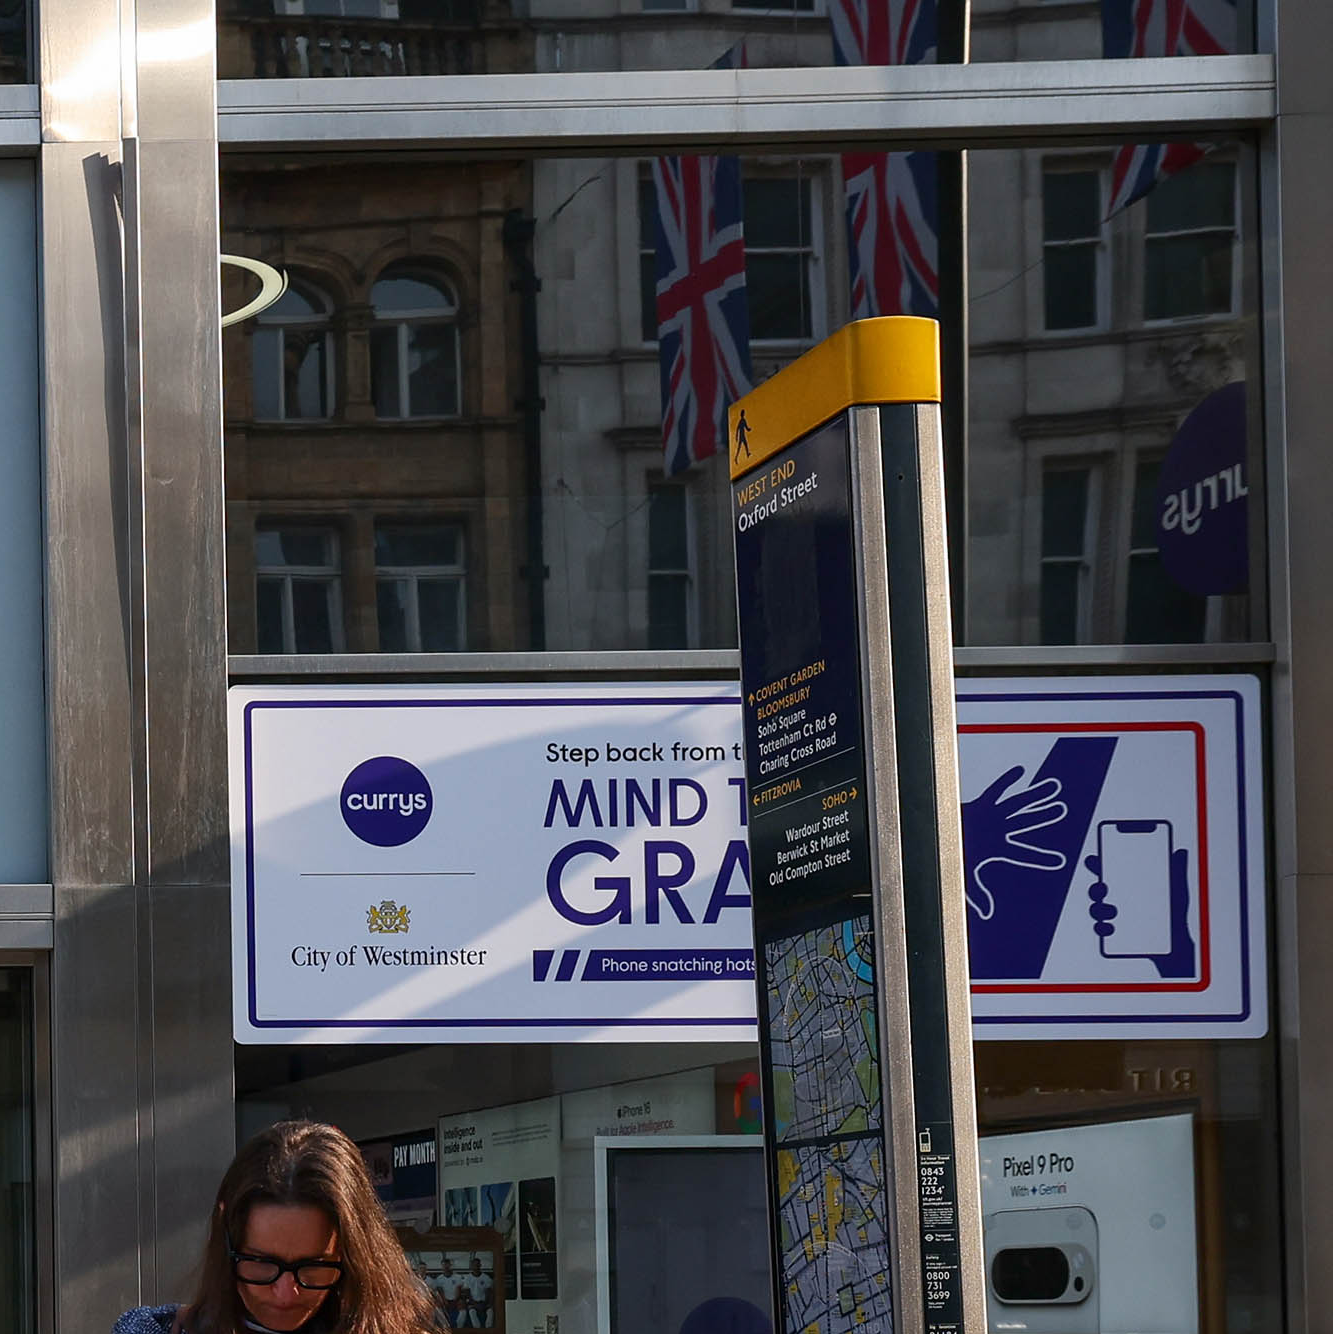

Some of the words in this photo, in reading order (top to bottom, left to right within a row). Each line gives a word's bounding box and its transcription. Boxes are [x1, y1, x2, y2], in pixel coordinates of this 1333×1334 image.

[737, 475, 768, 508] WEST
[770, 459, 796, 489] END
[738, 494, 778, 533] Oxford
[780, 471, 819, 508] Street
[756, 676, 789, 703] COVENT
[790, 659, 827, 687] GARDEN
[757, 685, 812, 721] BLOOMSBURY
[758, 722, 778, 740] Soho
[779, 708, 807, 731] Square
[759, 729, 802, 758] Tottenham
[803, 721, 814, 738] Ct
[816, 715, 827, 734] Rd
[546, 742, 599, 769] Step
[606, 742, 664, 763] back
[671, 741, 726, 762] from
[760, 754, 790, 776] Charing
[790, 741, 814, 762] Cross
[815, 731, 838, 753] Road
[345, 791, 429, 815] currys
[543, 778, 708, 828] MIND
[761, 777, 803, 804] FITZROVIA
[821, 790, 849, 811] SOHO
[785, 821, 822, 844] Wardour
[822, 809, 850, 831] Street
[776, 842, 809, 866] Berwick
[809, 839, 820, 855] St
[821, 829, 851, 851] Market
[768, 869, 784, 887] Old
[785, 858, 823, 880] Compton
[824, 848, 852, 869] Street
[545, 839, 752, 926] GRA
[291, 946, 331, 973] City
[335, 945, 358, 968] of
[362, 945, 488, 967] Westminster
[601, 957, 649, 973] Phone
[651, 957, 723, 976] snatching
[726, 955, 756, 973] hots
[444, 1126, 476, 1140] Intelligence
[461, 1140, 472, 1152] and
[473, 1138, 483, 1150] out
[394, 1145, 408, 1168] PAY
[1004, 1156, 1034, 1178] Pixel
[1038, 1155, 1046, 1174] 9
[1050, 1153, 1074, 1173] Pro
[921, 1167, 945, 1176] 0843
[922, 1177, 938, 1186] 222
[1039, 1183, 1067, 1196] Gemini
[926, 1272, 950, 1281] 0800
[927, 1282, 943, 1291] 731
[927, 1291, 950, 1300] 3699
